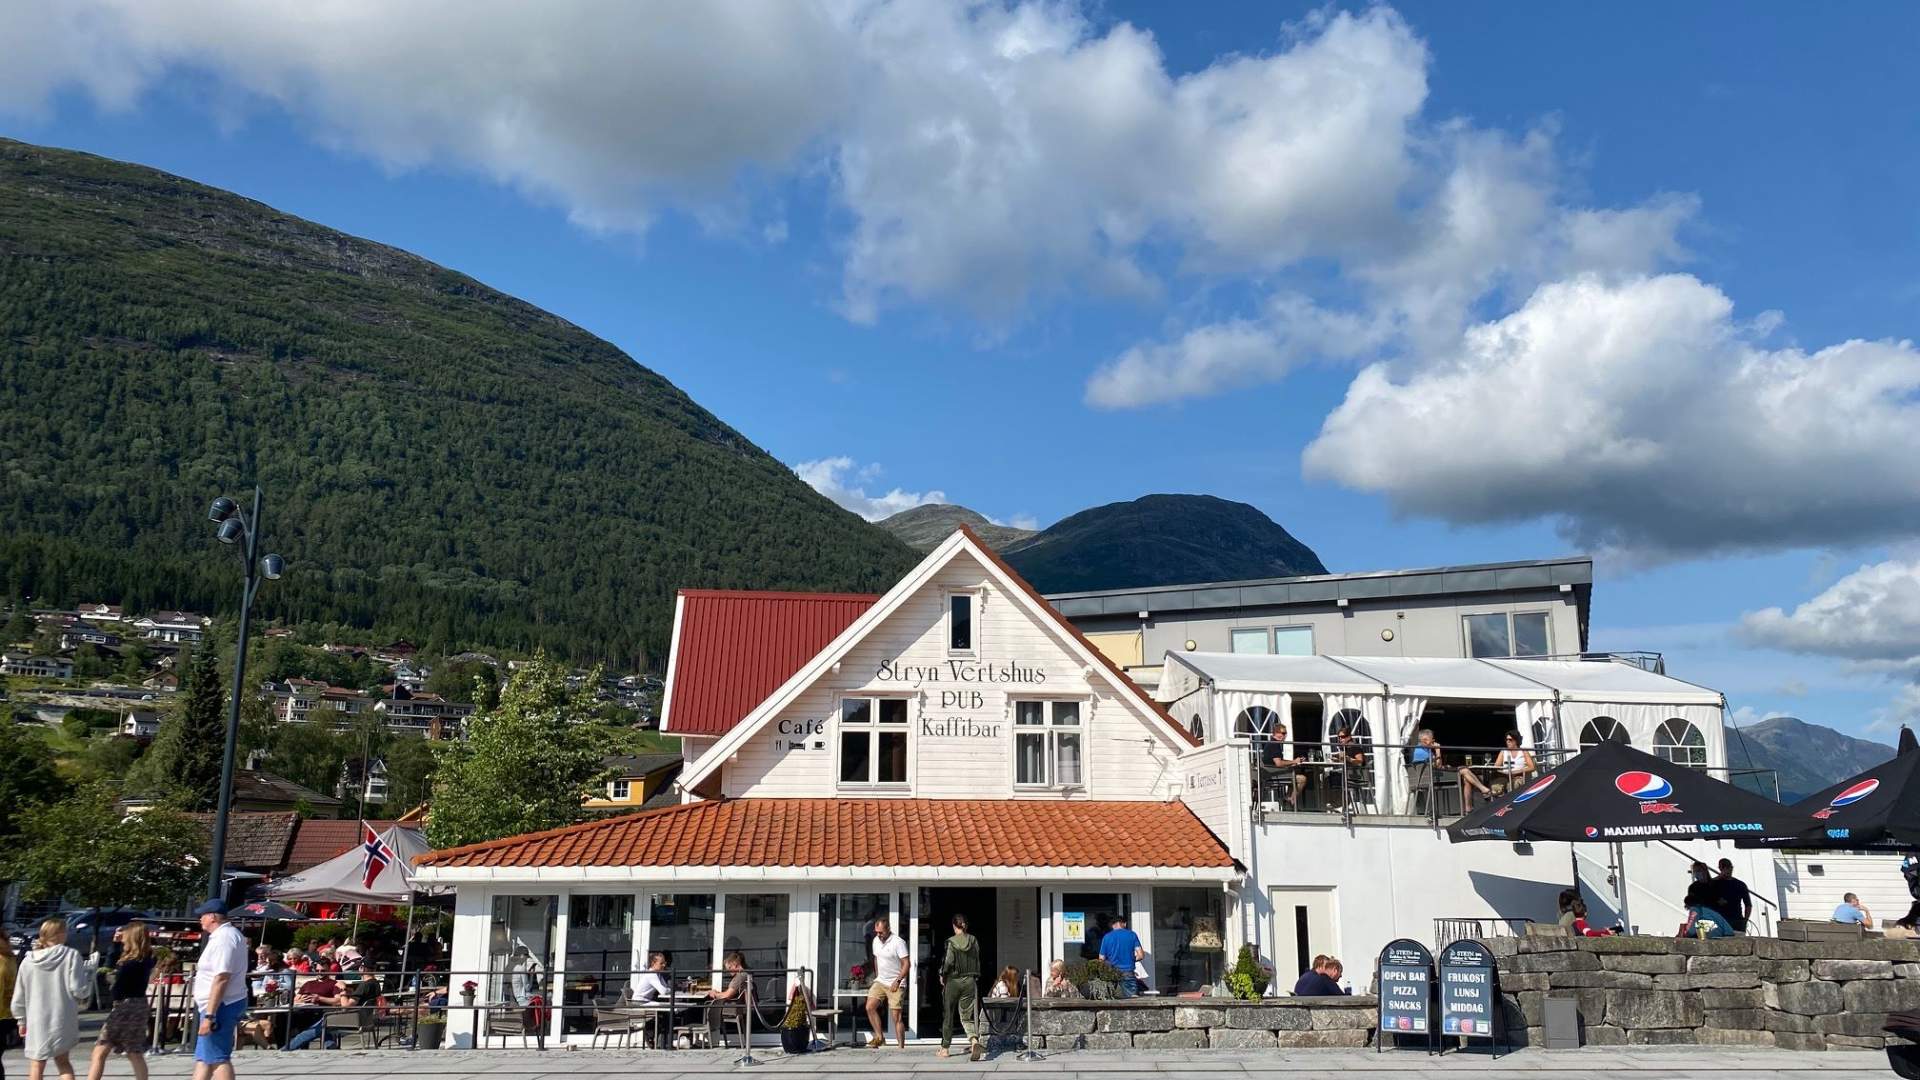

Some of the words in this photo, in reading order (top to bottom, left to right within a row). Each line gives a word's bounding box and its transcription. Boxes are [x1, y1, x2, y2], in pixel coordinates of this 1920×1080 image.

[876, 659, 939, 688] Stryn
[949, 660, 1046, 683] Vertshus
[941, 690, 983, 709] PUB
[778, 719, 824, 735] Café
[922, 717, 1000, 738] Kaffibar
[1604, 825, 1663, 836] MAXIMUM
[1664, 824, 1698, 834] TASTE
[1700, 824, 1719, 832] NO
[1722, 823, 1764, 831] SUGAR
[1384, 971, 1407, 981] OPEN
[1409, 971, 1426, 982] BAR
[1448, 973, 1486, 983] FRUKOST
[1393, 986, 1417, 996] PIZZA
[1454, 988, 1479, 998] LUNSJ
[1388, 1001, 1422, 1011] SNACKS
[1451, 1002, 1484, 1013] MIDDAG
